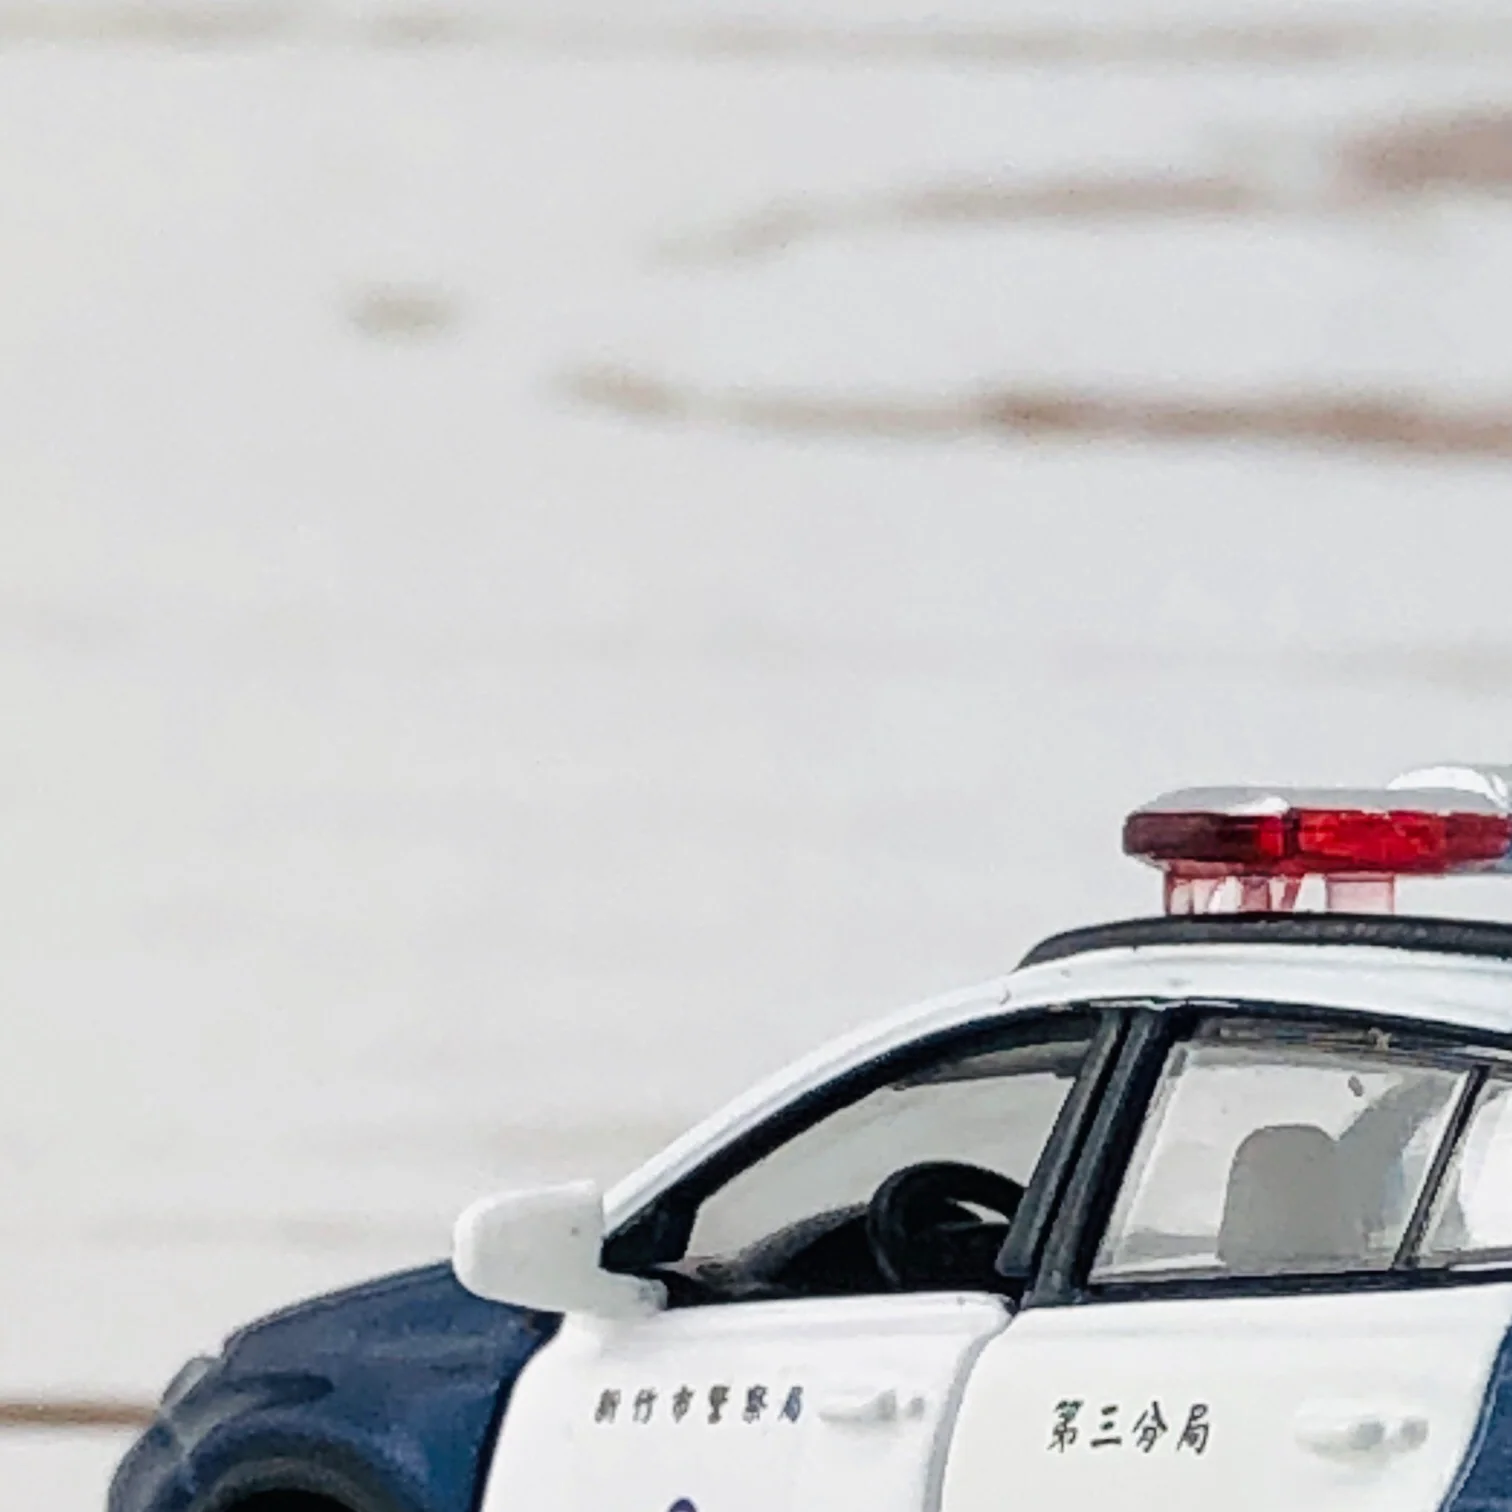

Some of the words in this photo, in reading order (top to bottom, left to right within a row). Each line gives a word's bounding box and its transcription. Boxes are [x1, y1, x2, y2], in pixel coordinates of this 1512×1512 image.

[595, 1384, 804, 1424] 新竹市警察局
[1047, 1400, 1210, 1454] 第三分局
